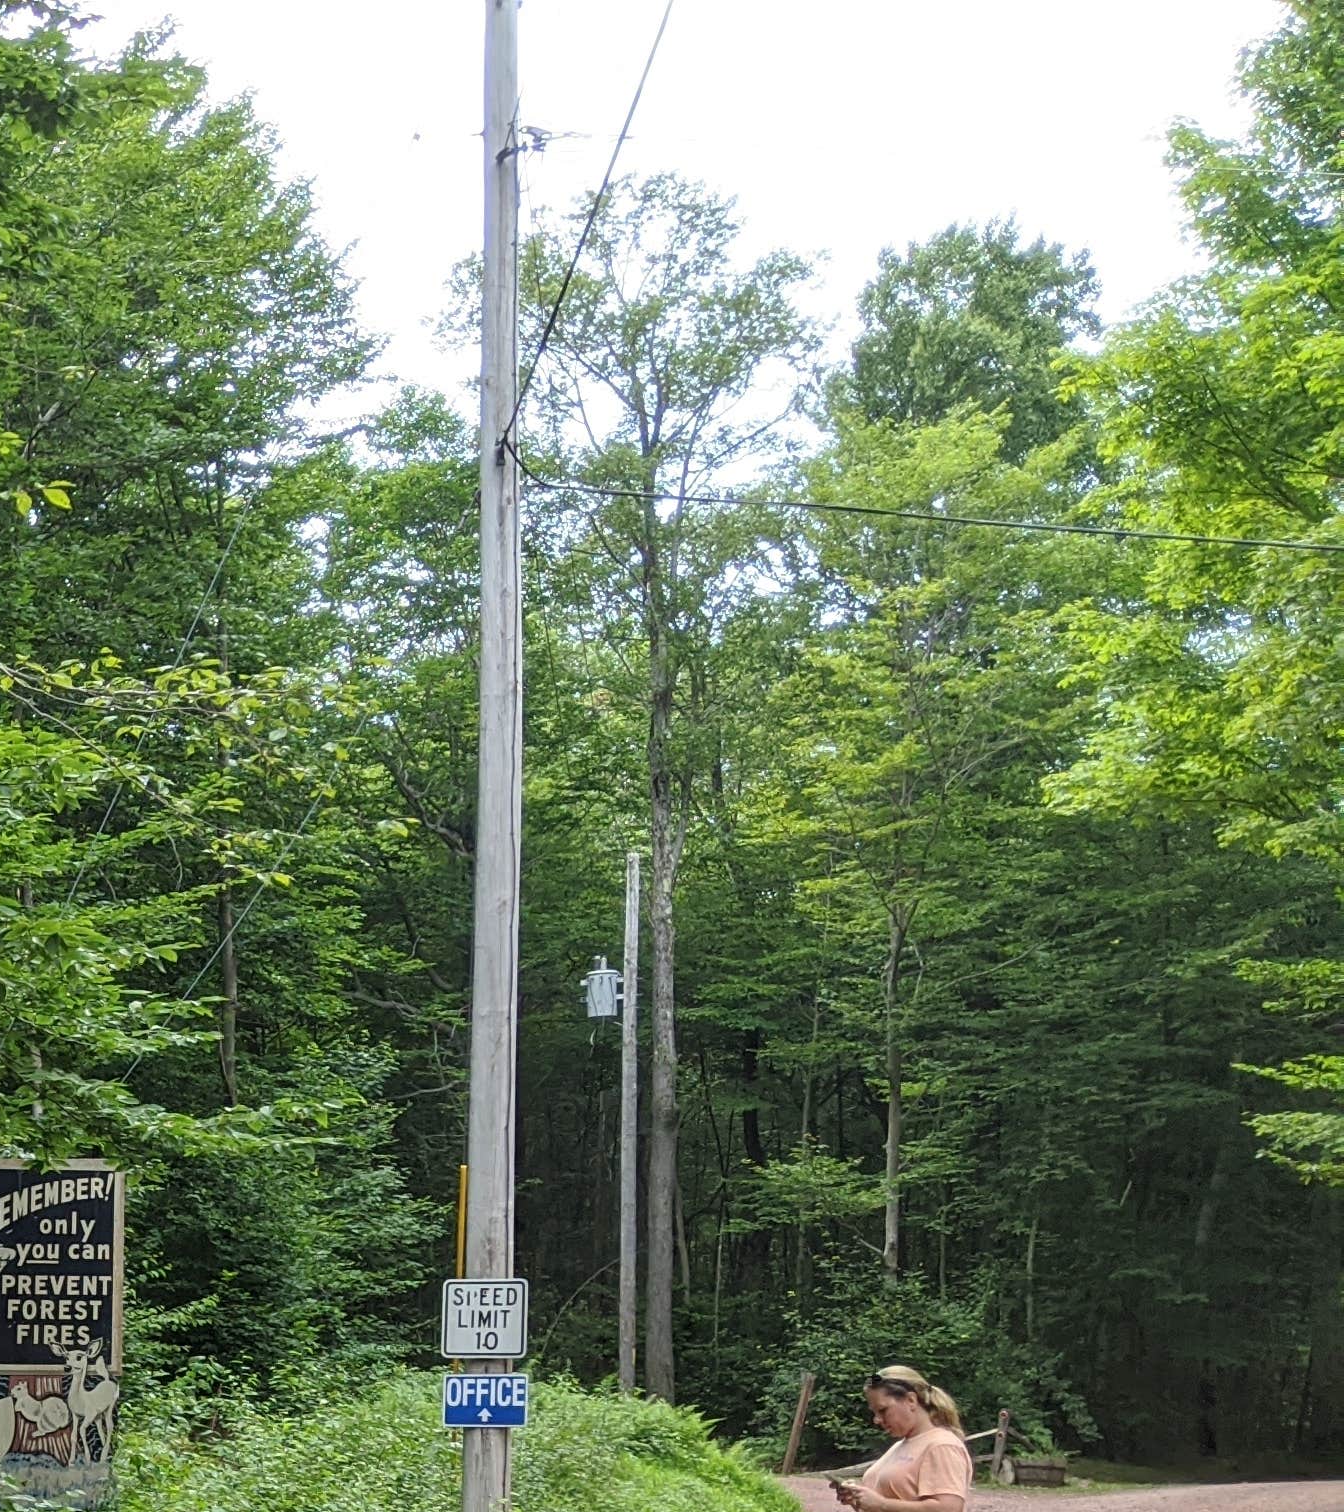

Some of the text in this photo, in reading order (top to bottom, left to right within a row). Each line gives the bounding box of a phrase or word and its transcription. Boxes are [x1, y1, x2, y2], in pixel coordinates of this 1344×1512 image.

[39, 1211, 96, 1242] only
[16, 1243, 110, 1267] you can
[1, 1274, 112, 1296] PREVENT
[7, 1299, 103, 1321] FOREST
[457, 1309, 510, 1329] LIMIT
[16, 1324, 90, 1346] FIRES
[475, 1331, 499, 1350] 10
[446, 1377, 526, 1407] OFFICE
